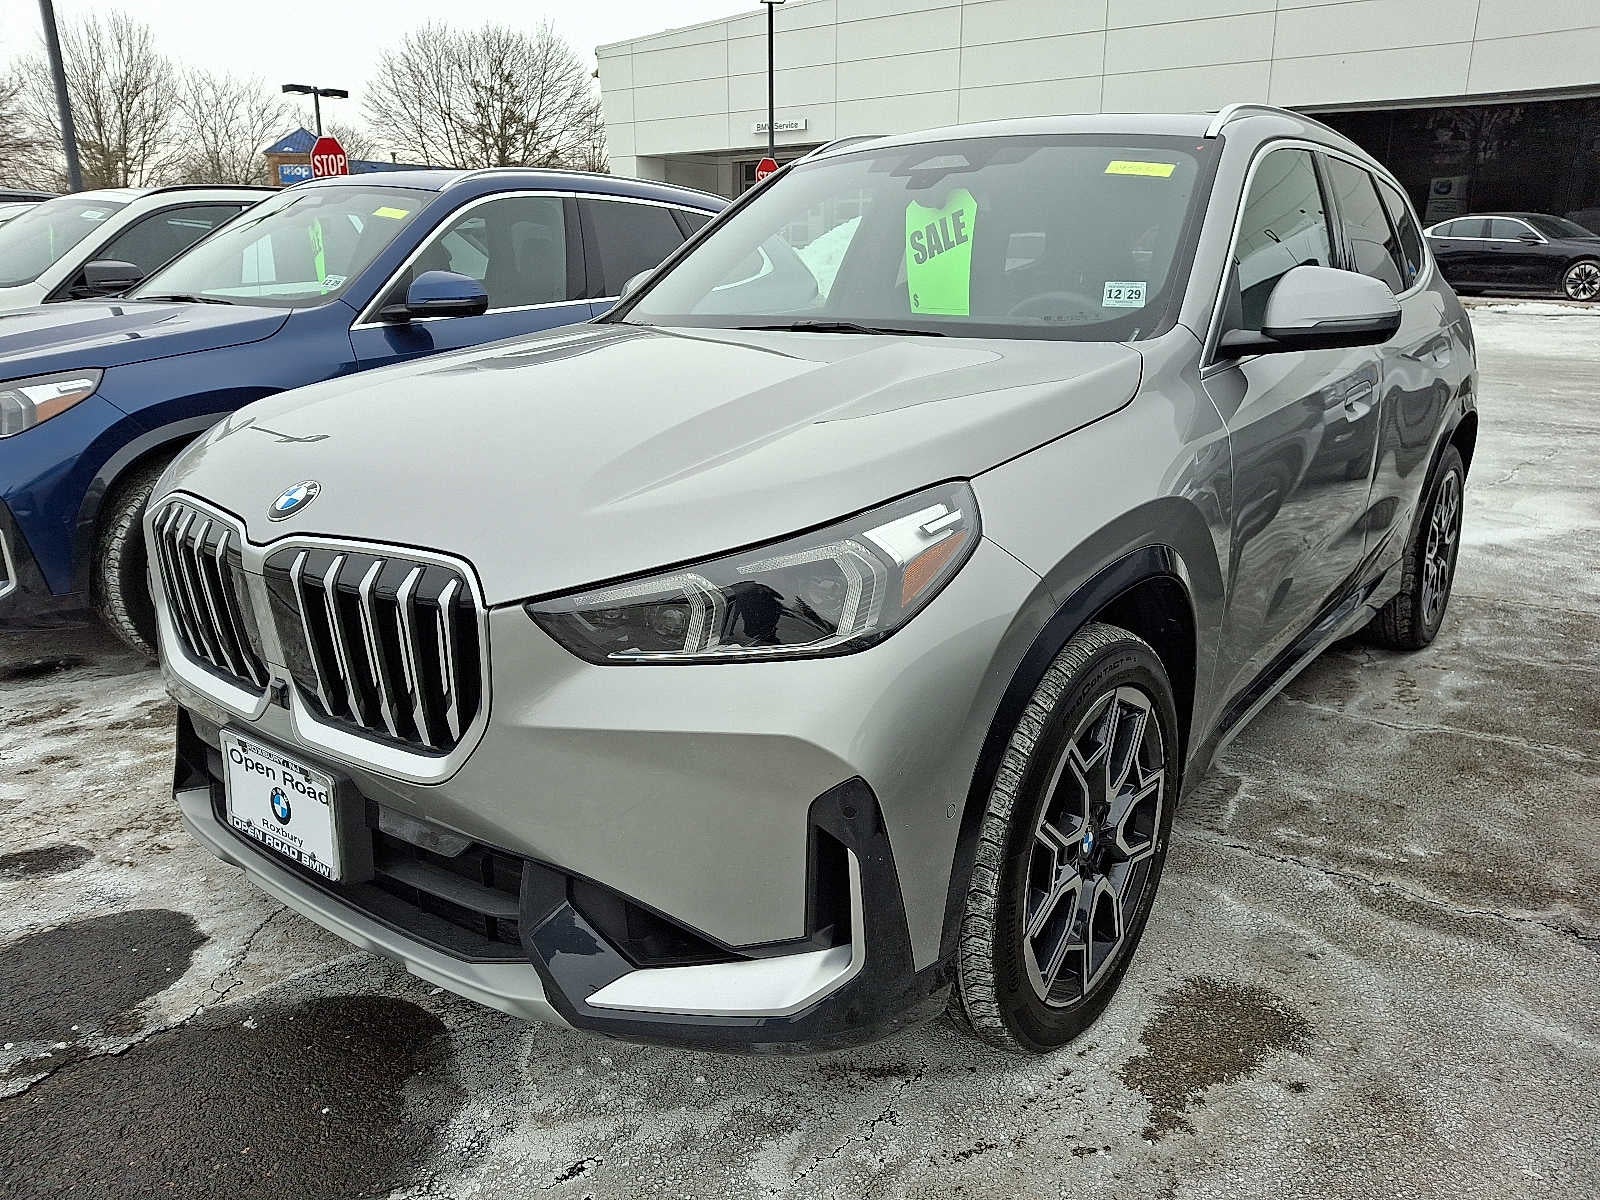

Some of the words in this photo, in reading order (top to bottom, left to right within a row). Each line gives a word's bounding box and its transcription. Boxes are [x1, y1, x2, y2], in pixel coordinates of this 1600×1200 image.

[756, 123, 770, 131] BM
[774, 121, 799, 130] Service
[313, 154, 346, 176] STOP
[910, 208, 969, 265] SALE
[1106, 289, 1122, 299] 12
[1126, 289, 1142, 300] 29
[229, 748, 276, 780] Open
[282, 770, 329, 806] Road
[233, 817, 263, 841] OPEN
[265, 834, 298, 859] ROAD
[301, 852, 330, 877] BMW
[262, 818, 304, 847] Roxbury
